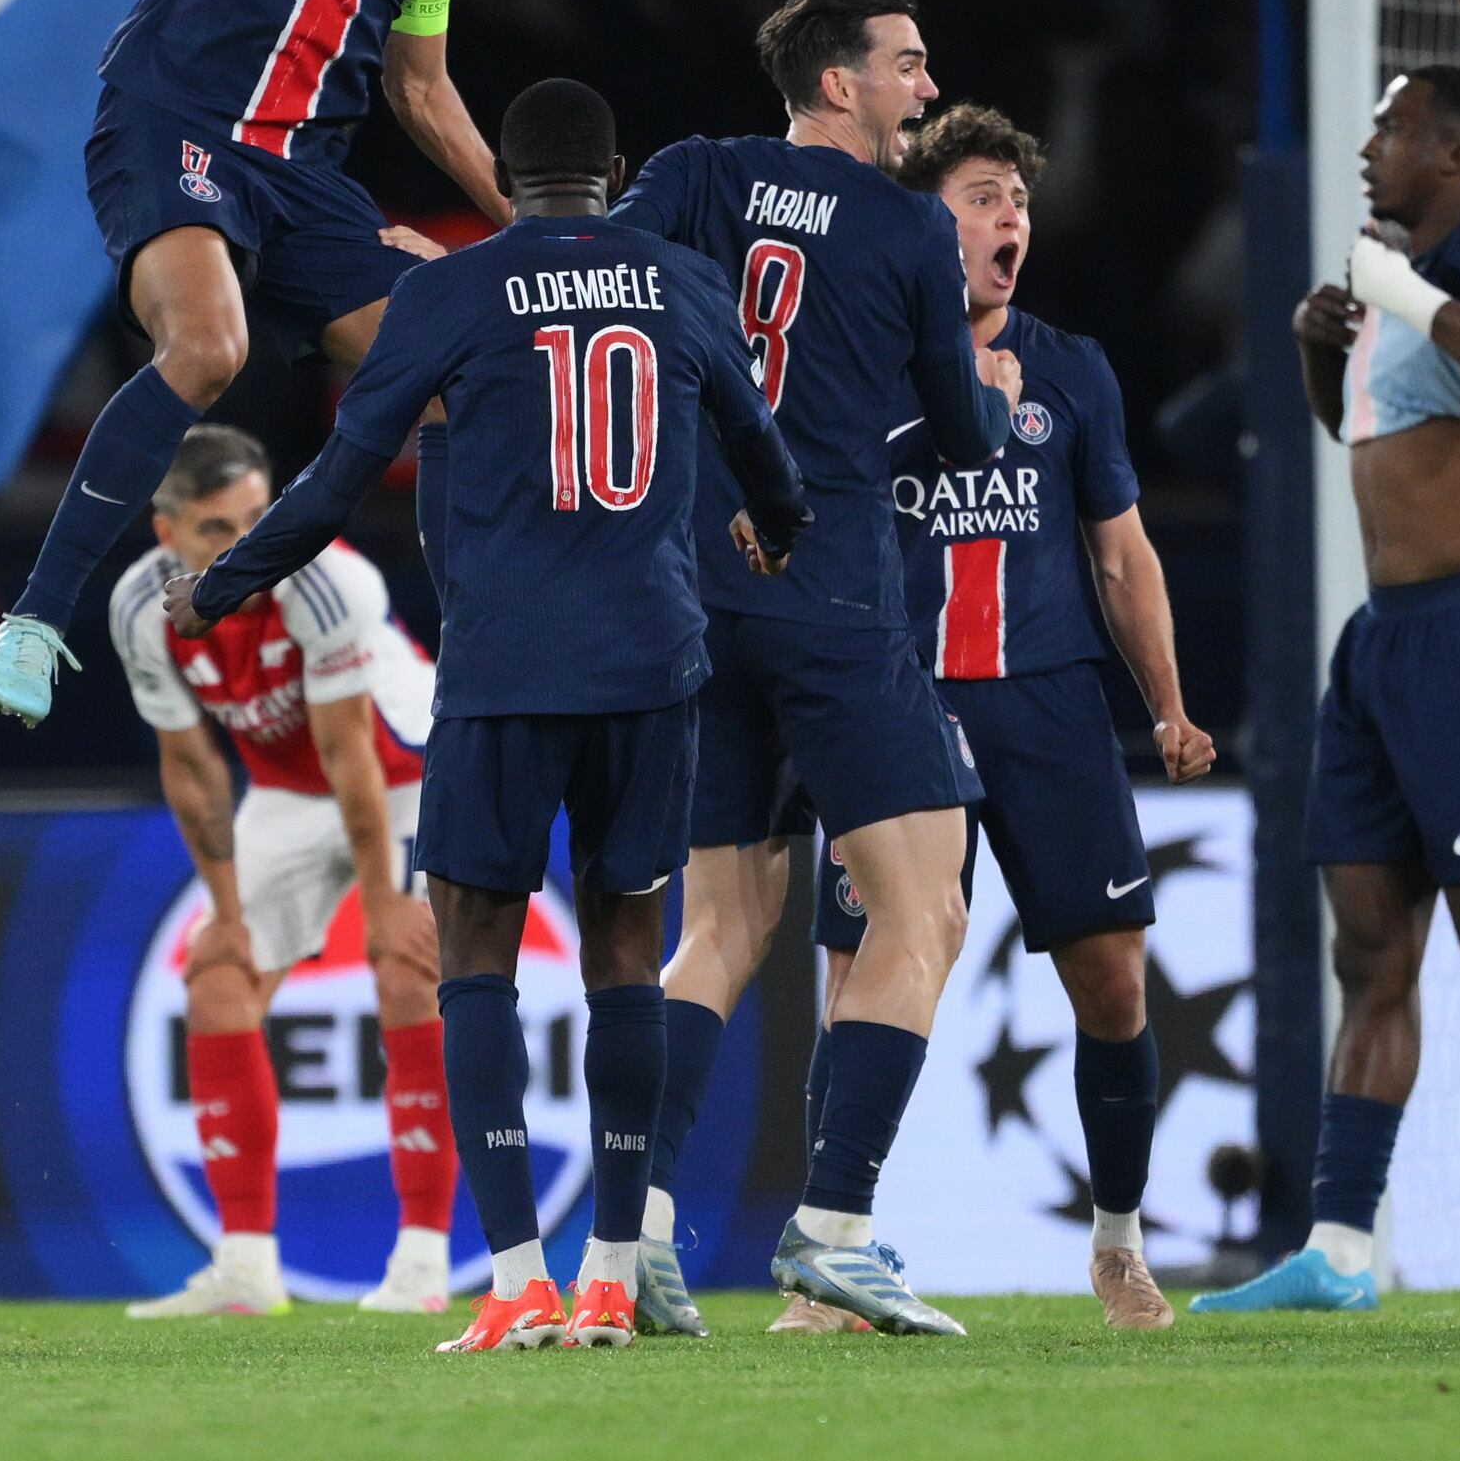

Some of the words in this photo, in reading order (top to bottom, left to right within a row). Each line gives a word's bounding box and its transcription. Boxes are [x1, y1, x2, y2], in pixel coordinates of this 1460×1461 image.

[744, 180, 839, 236] FABIAN
[505, 263, 665, 315] O.DEMBÉLÉ
[738, 237, 806, 417] 8
[533, 324, 659, 512] 10
[892, 467, 1040, 521] QATAR
[929, 507, 1040, 537] AIRWAYS
[485, 1128, 526, 1149] PARIS
[604, 1130, 647, 1152] PARIS
